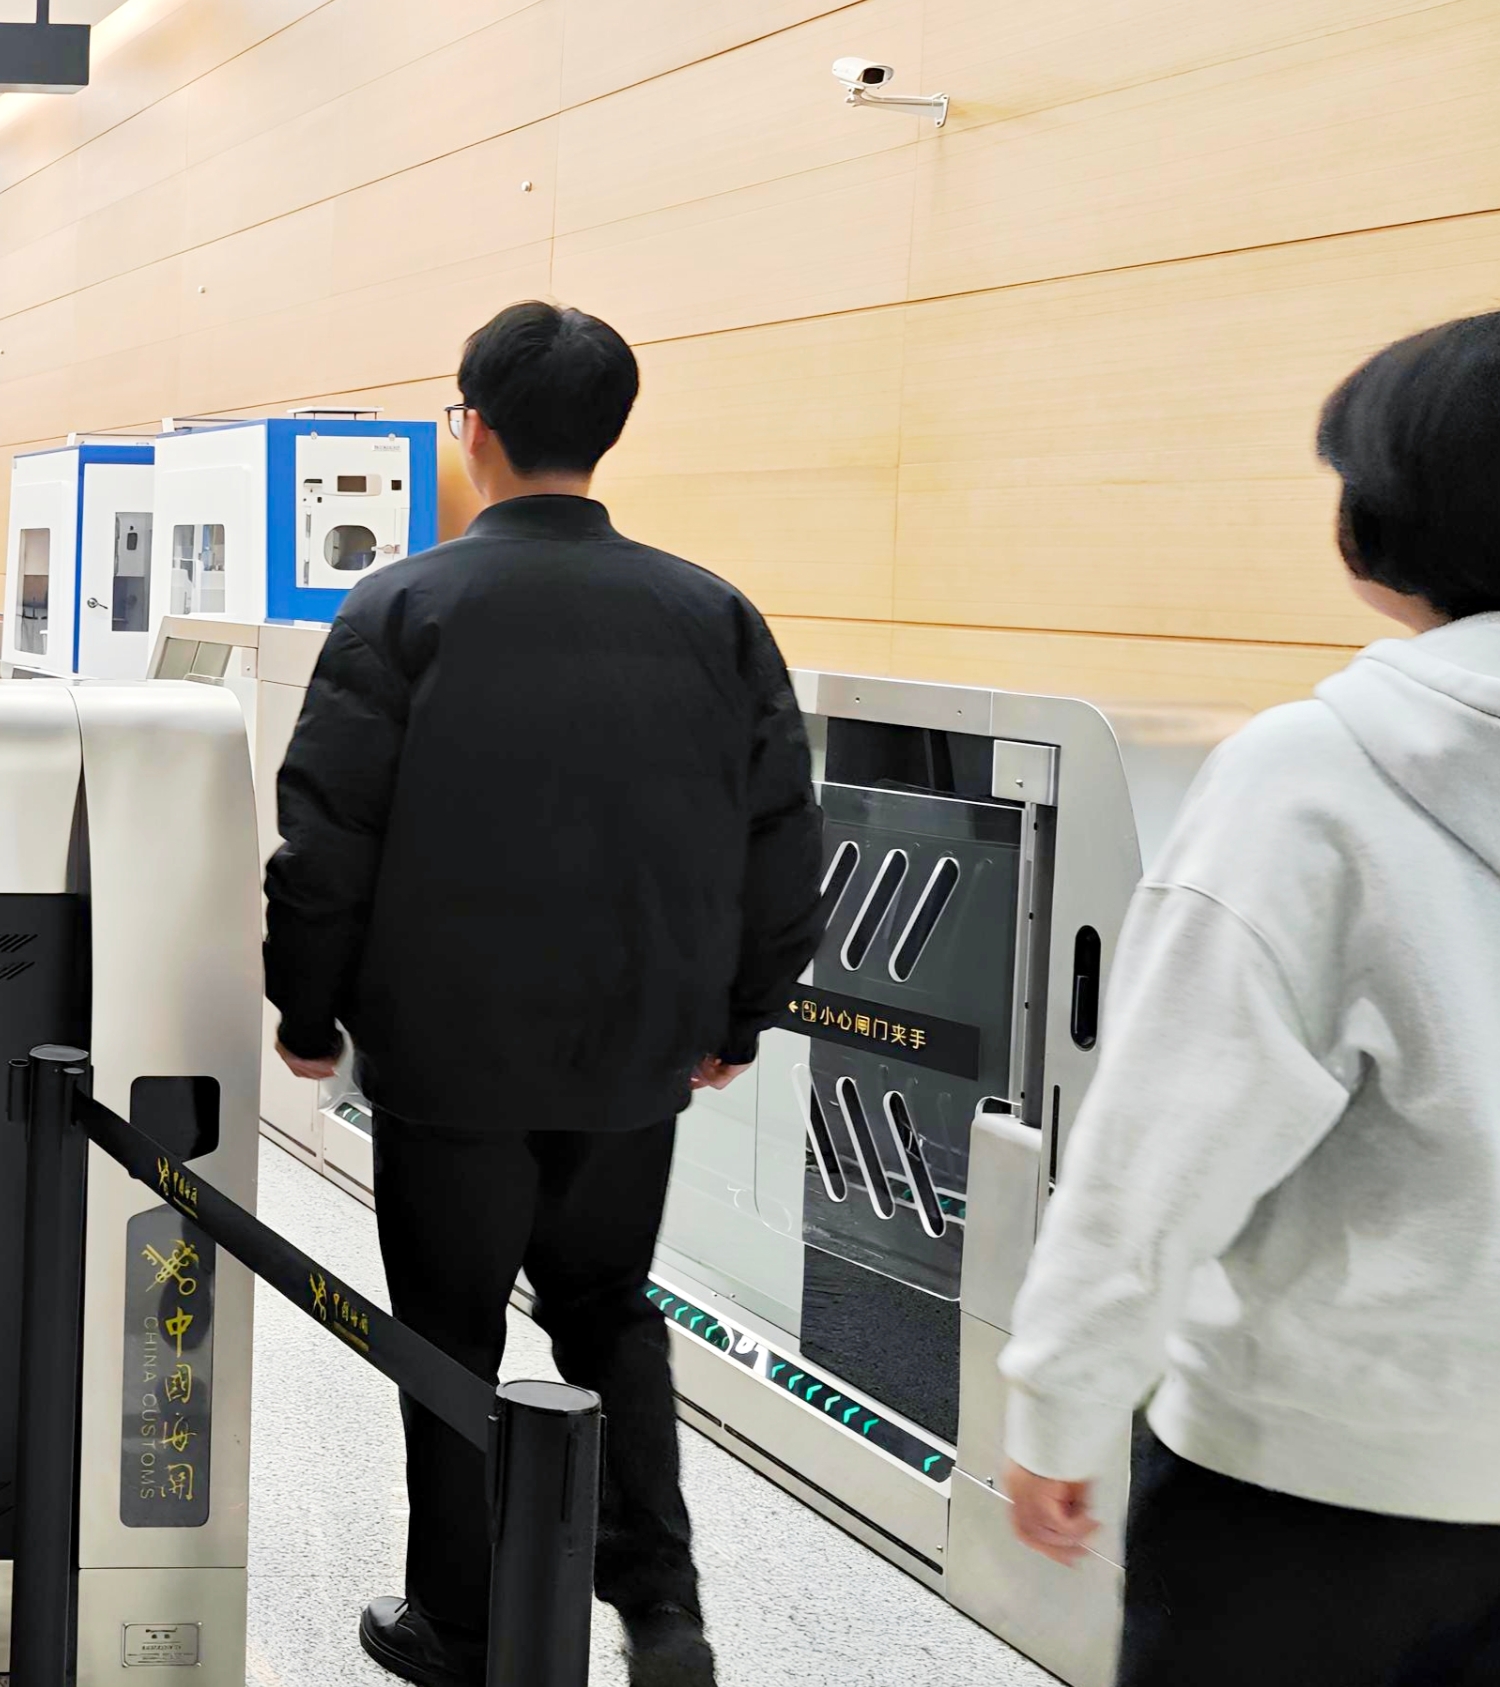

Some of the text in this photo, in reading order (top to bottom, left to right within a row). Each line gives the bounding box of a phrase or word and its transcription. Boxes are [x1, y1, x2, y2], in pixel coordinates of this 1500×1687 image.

[820, 1006, 927, 1050] 小心闸门夹手
[140, 1315, 158, 1500] CHINA CUSTOMS
